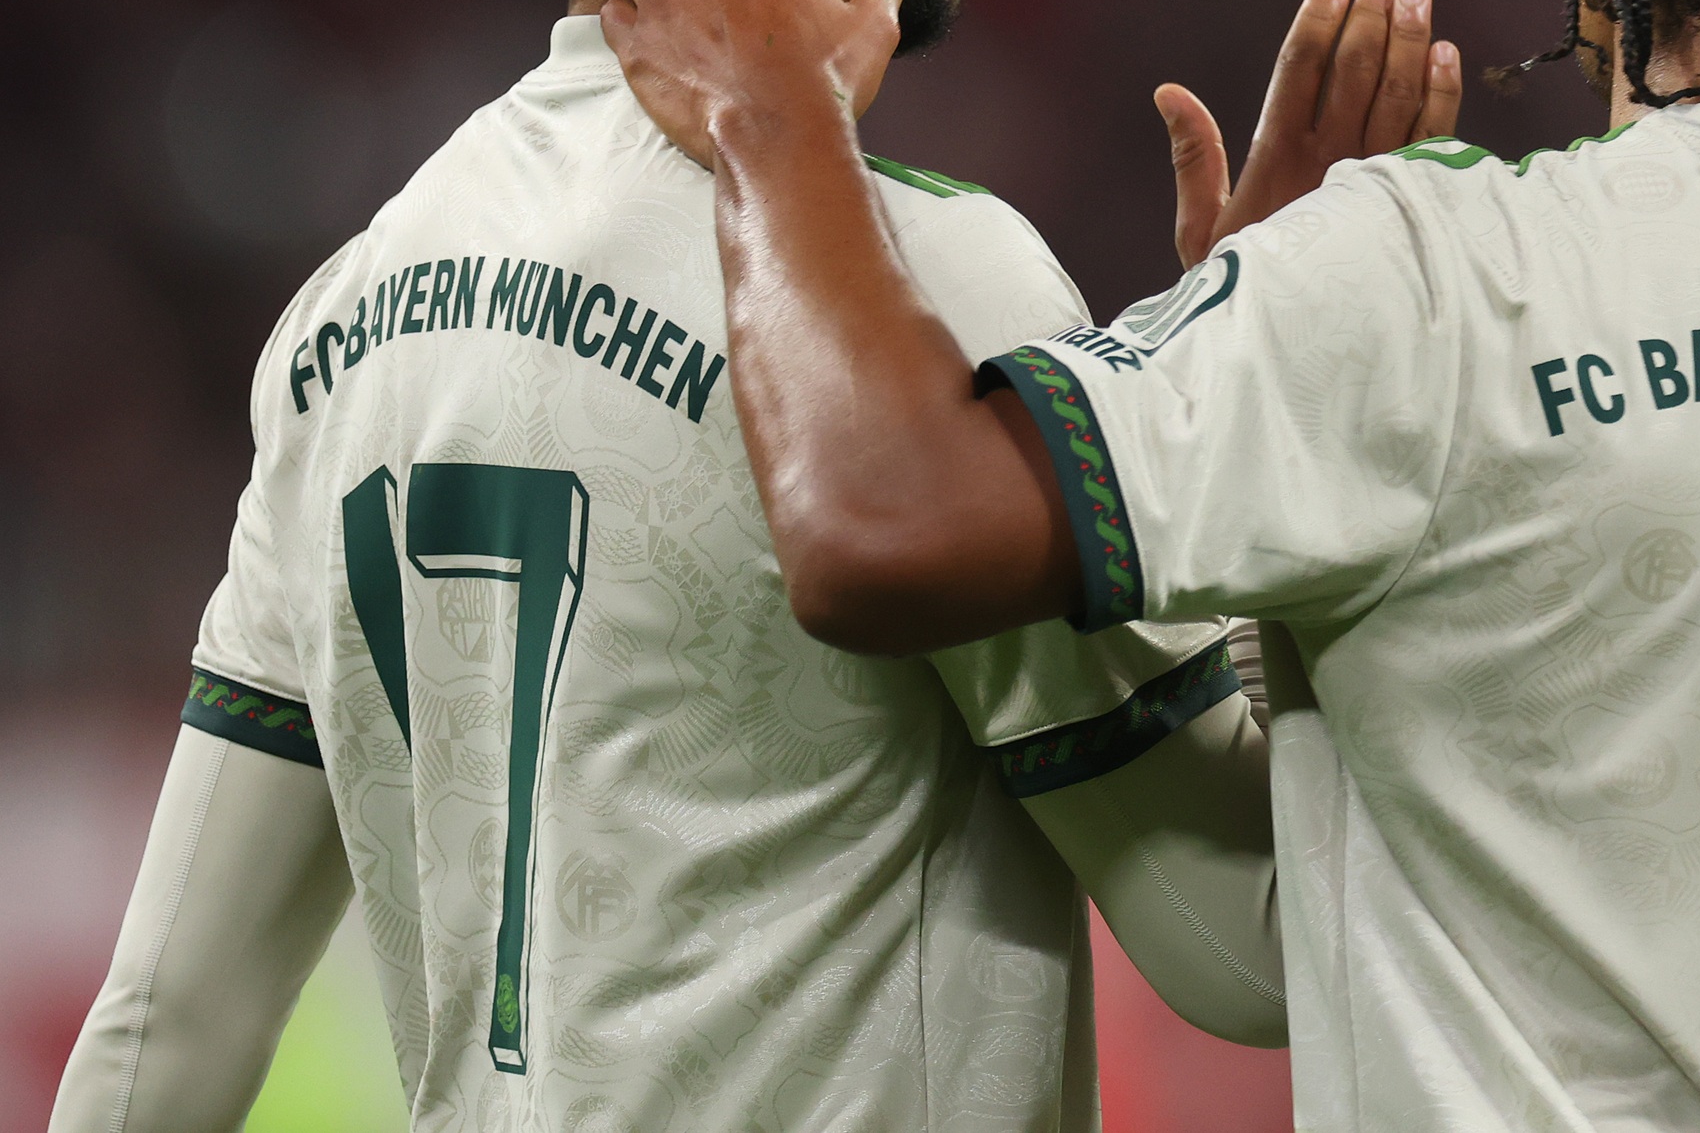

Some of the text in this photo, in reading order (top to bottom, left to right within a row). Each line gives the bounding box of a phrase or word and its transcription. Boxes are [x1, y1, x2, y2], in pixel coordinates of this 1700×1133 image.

[290, 256, 727, 424] FC BAYERN MÜNCHEN
[1531, 353, 1625, 437] FC
[342, 463, 590, 1076] 17
